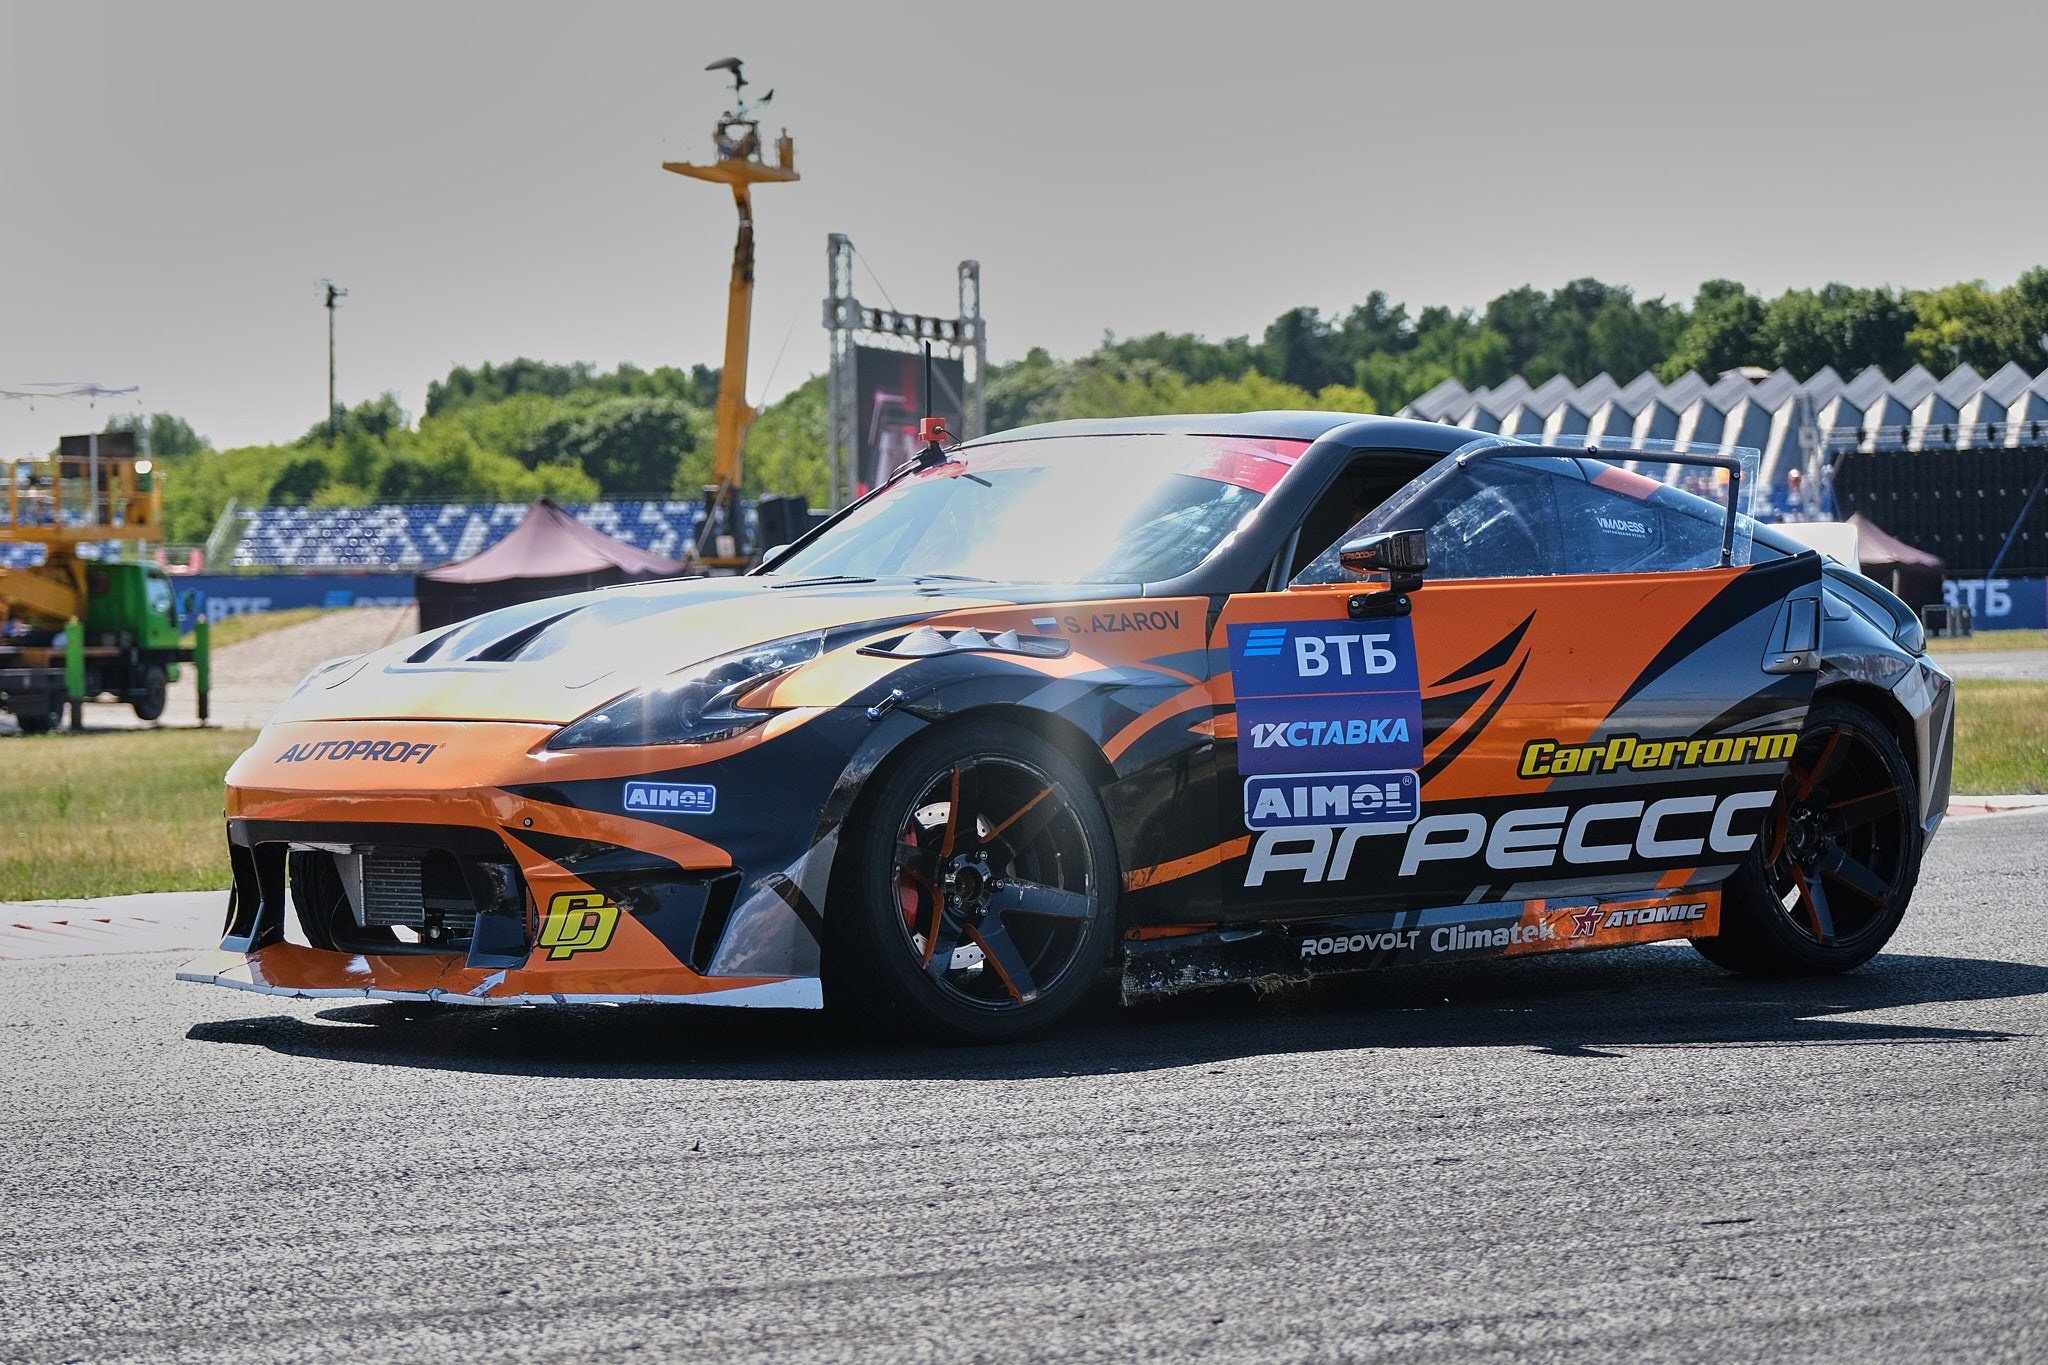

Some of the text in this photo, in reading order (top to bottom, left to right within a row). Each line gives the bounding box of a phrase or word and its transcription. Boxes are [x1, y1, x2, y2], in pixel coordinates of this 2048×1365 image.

[1064, 610, 1179, 633] S. AZAROV
[1294, 633, 1397, 677] ВТБ
[274, 740, 438, 765] AUTOPROFI
[1520, 733, 1798, 776] CarPerform
[1603, 903, 1706, 928] ATOMIC
[1300, 930, 1421, 957] ROBOVOLT
[1430, 917, 1556, 952] Climatek
